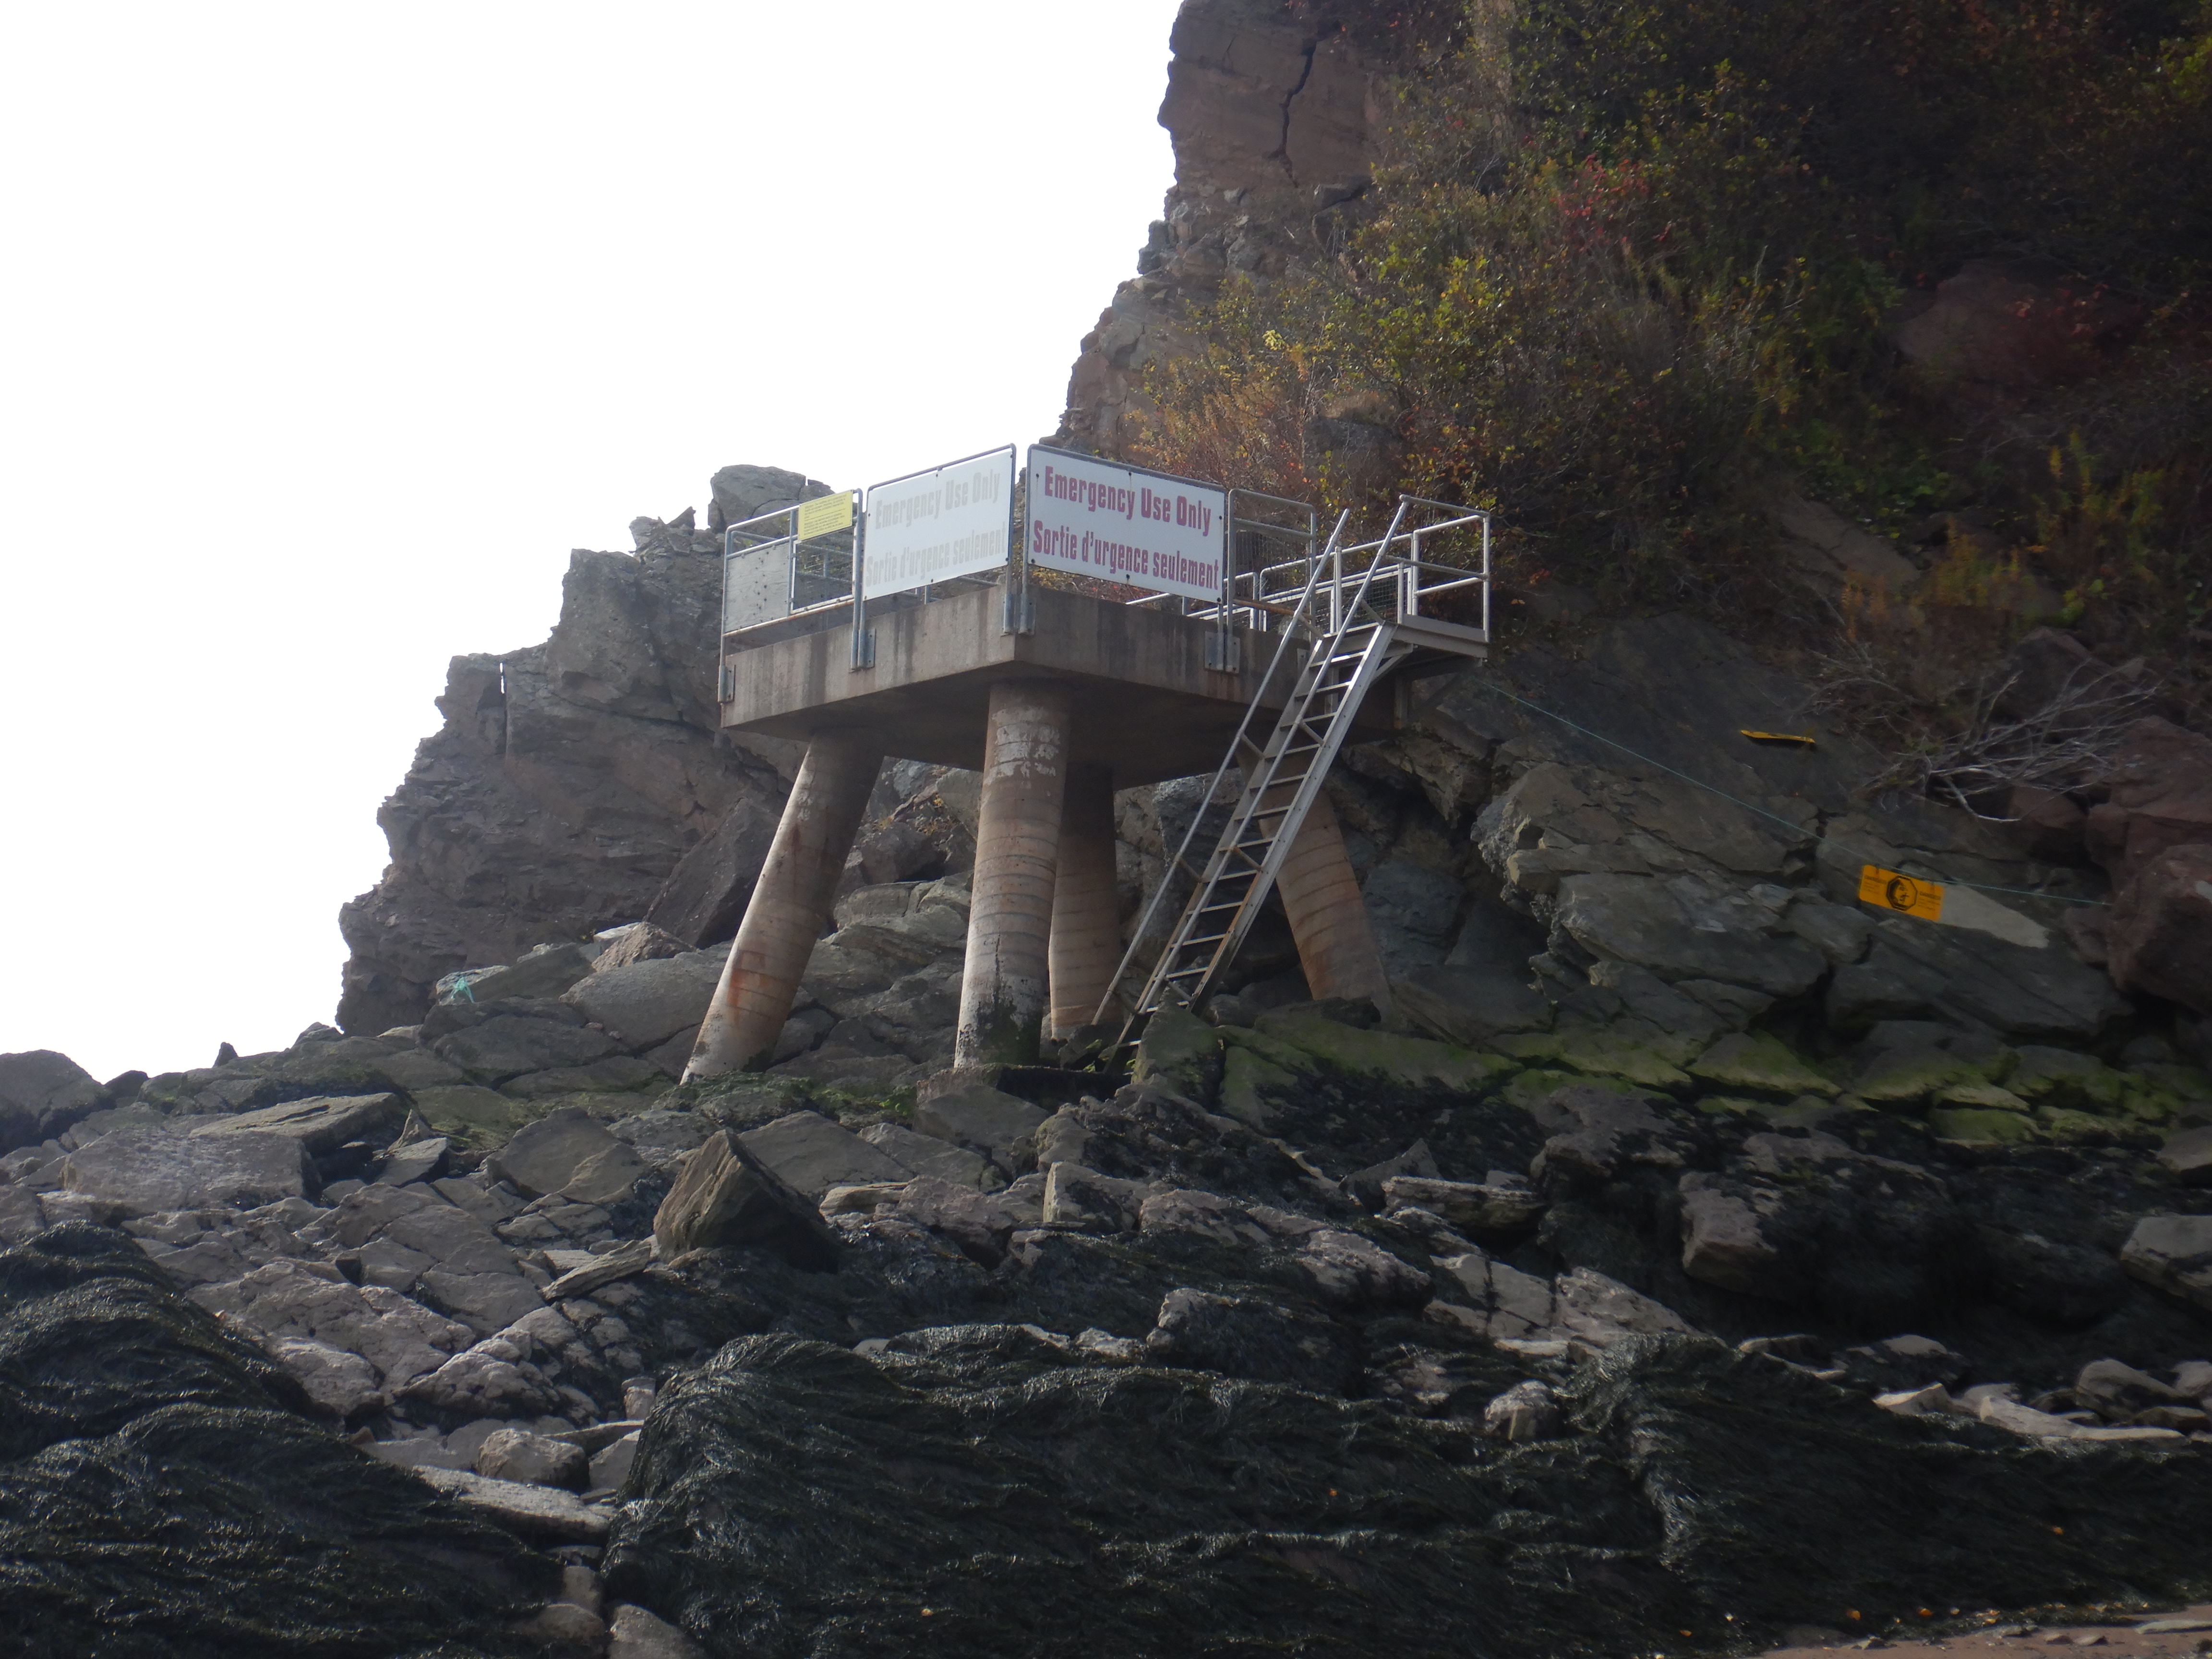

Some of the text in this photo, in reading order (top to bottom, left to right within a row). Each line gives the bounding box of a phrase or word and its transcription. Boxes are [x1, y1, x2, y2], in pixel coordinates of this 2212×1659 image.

[876, 489, 942, 529] Emergency
[945, 479, 969, 511] Use
[973, 469, 1000, 504] Only
[1045, 466, 1211, 537] Emergency Use Only
[866, 521, 1006, 587] Sortie d'urgence seulement
[1033, 520, 1219, 590] Sortie d'urgence seulement
